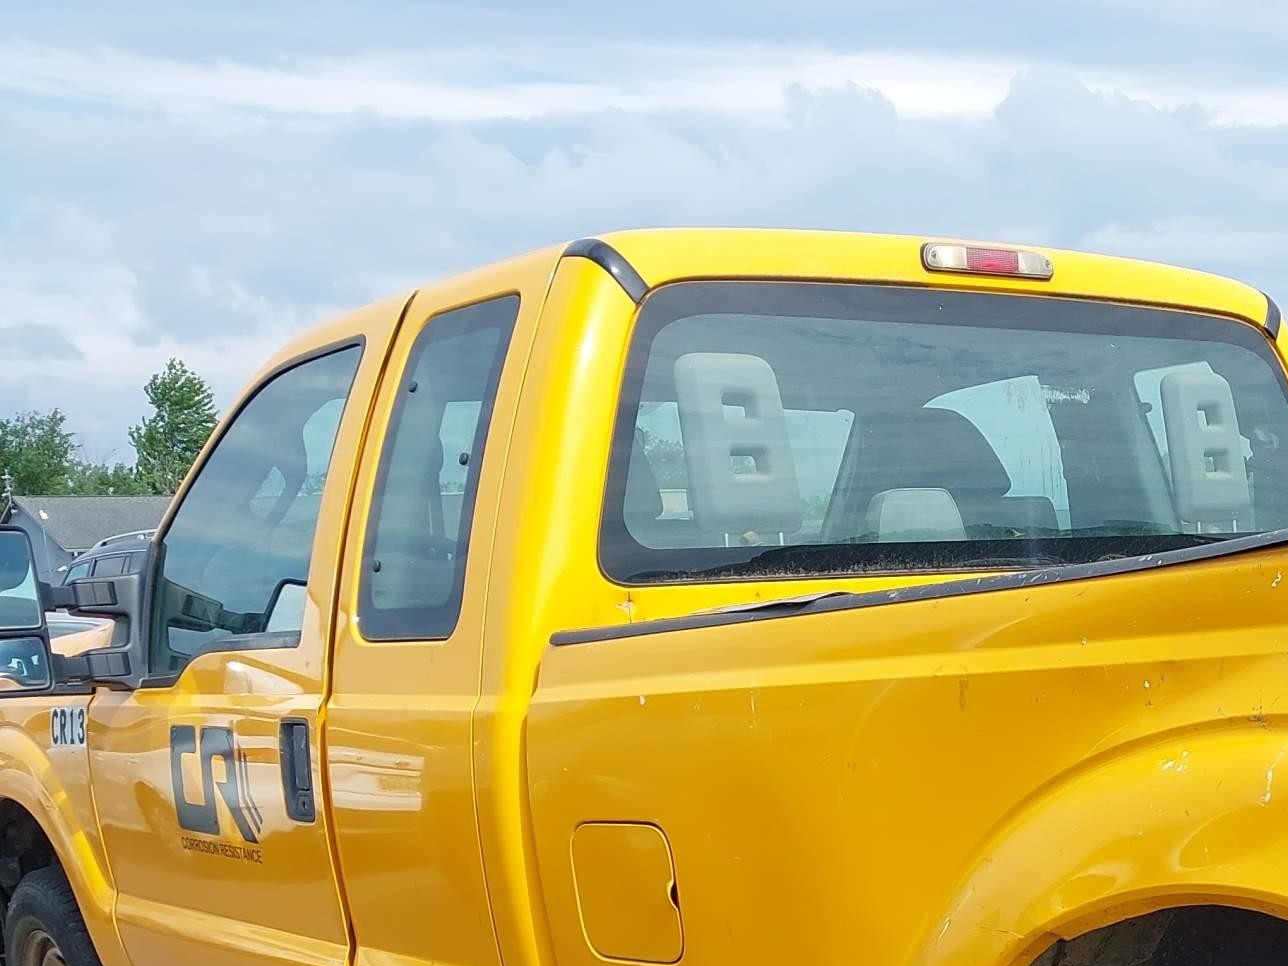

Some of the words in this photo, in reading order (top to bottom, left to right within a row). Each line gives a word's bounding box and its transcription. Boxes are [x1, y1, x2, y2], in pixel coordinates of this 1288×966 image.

[51, 708, 86, 745] CR13
[181, 836, 220, 855] CORROSION
[219, 843, 263, 864] RESISTANCE
